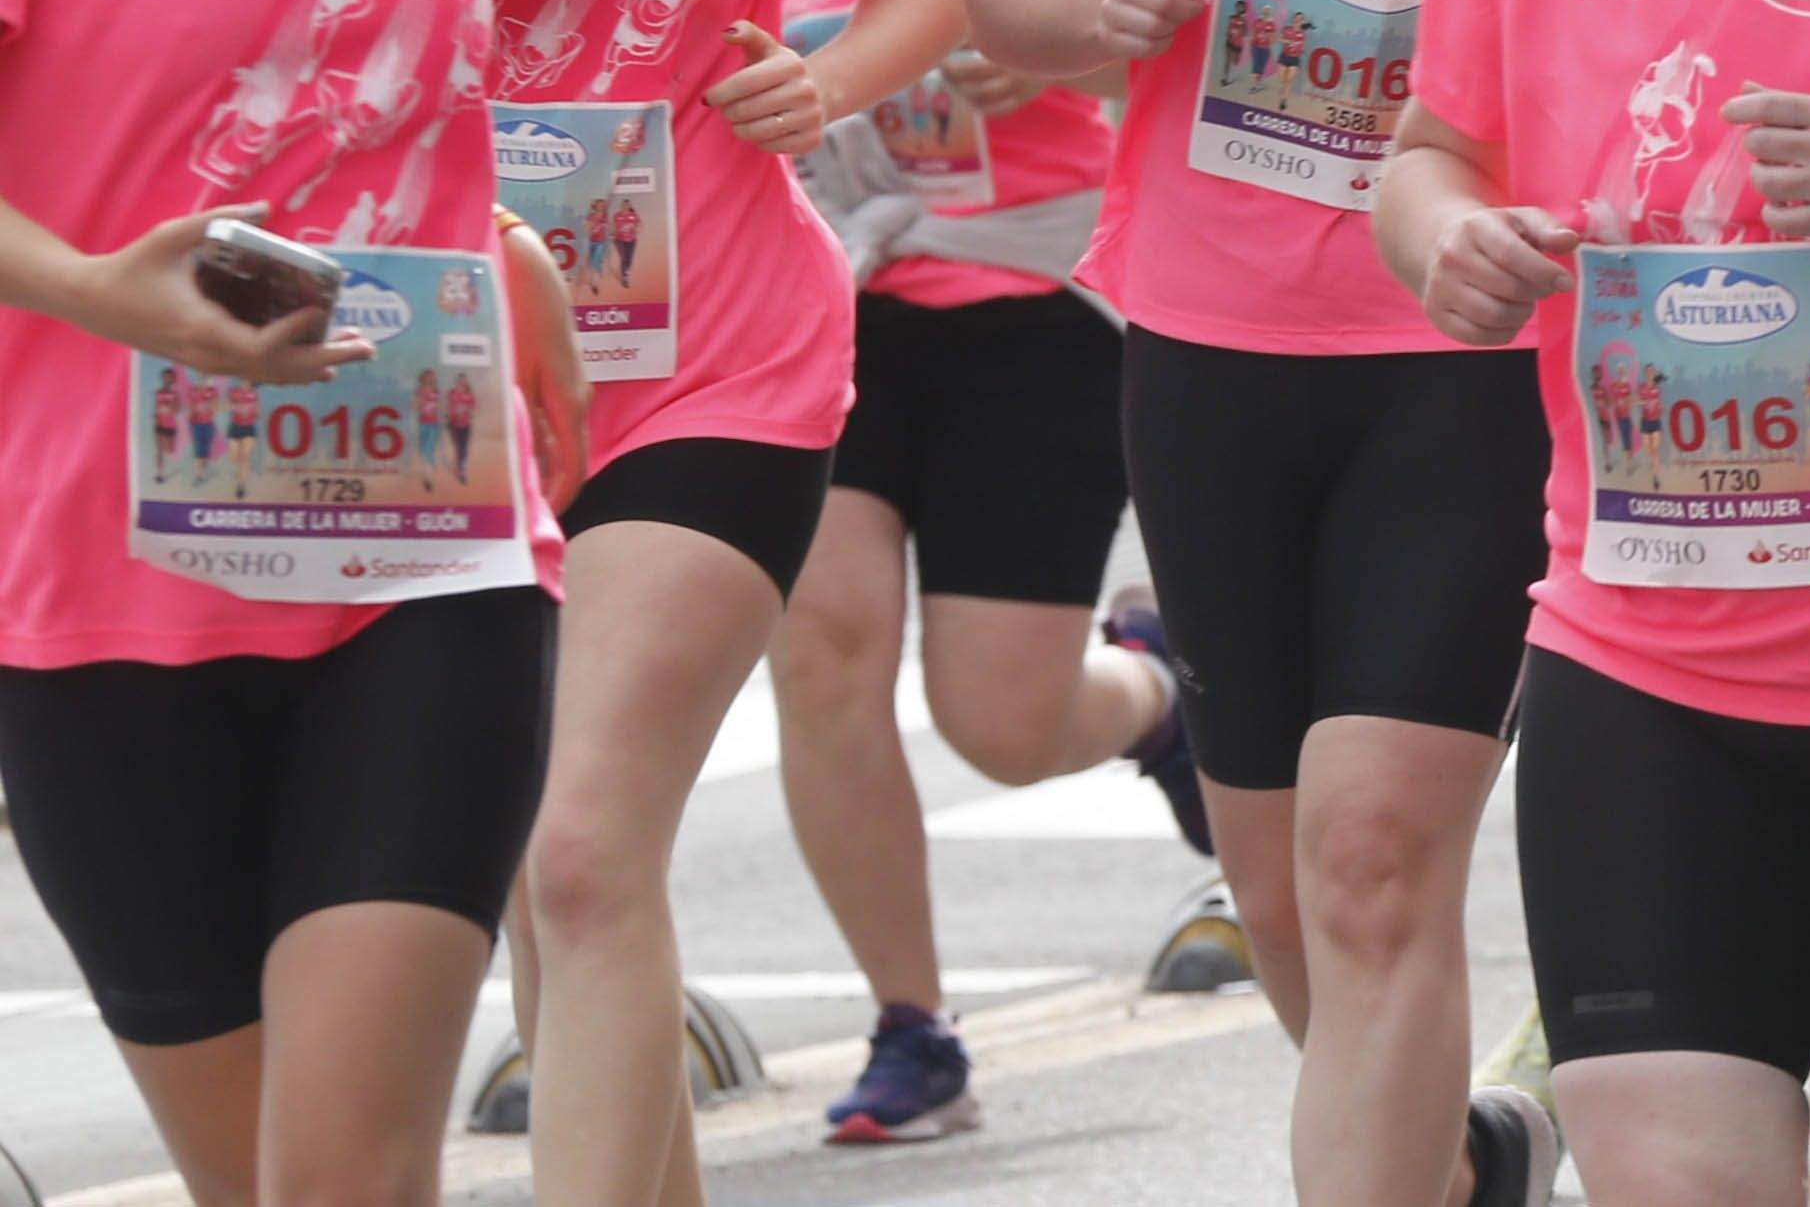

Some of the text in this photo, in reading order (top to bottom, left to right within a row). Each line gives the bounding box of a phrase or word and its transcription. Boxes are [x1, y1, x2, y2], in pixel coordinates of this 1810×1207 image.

[1307, 47, 1411, 102] 016
[1242, 110, 1393, 156] CARRERA DE LA MUJE
[1326, 106, 1377, 133] 3588
[496, 147, 577, 168] TURIANA
[1225, 138, 1316, 181] OYSHO
[1664, 295, 1787, 325] ASTURIANA
[583, 345, 641, 363] tander
[266, 404, 405, 460] 016
[1669, 397, 1798, 453] 016
[300, 479, 366, 503] 1729
[1699, 469, 1761, 493] 1730
[189, 508, 277, 531] CARRERA
[281, 510, 306, 530] DE
[310, 511, 335, 530] LA
[338, 510, 400, 531] MUJER
[1628, 497, 1686, 518] CARRERA
[1688, 499, 1711, 520] DE
[1713, 500, 1736, 519] LA
[1740, 497, 1801, 519] MUJER
[170, 547, 295, 579] OYSHO
[1617, 537, 1706, 566] OYSHO
[369, 557, 484, 580] Santander
